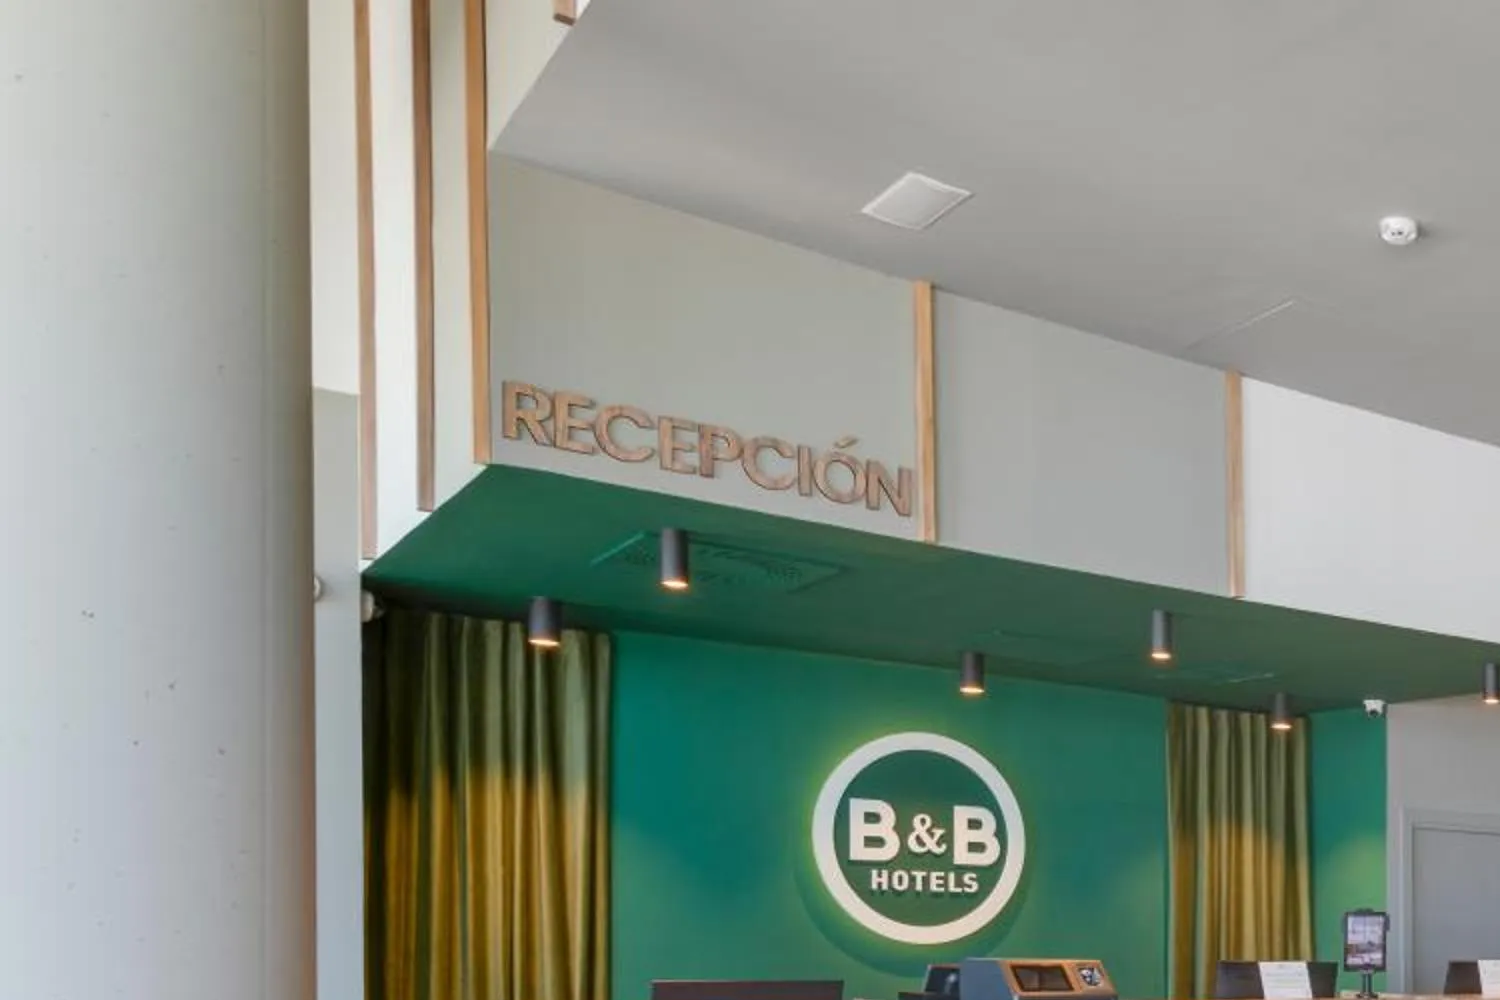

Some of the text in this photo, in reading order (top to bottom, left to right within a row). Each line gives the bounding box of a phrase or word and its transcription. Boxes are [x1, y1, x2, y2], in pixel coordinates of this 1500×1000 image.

[502, 380, 913, 516] RECEPCIÓN
[849, 797, 1001, 867] B&B
[870, 869, 980, 893] HOTELS
